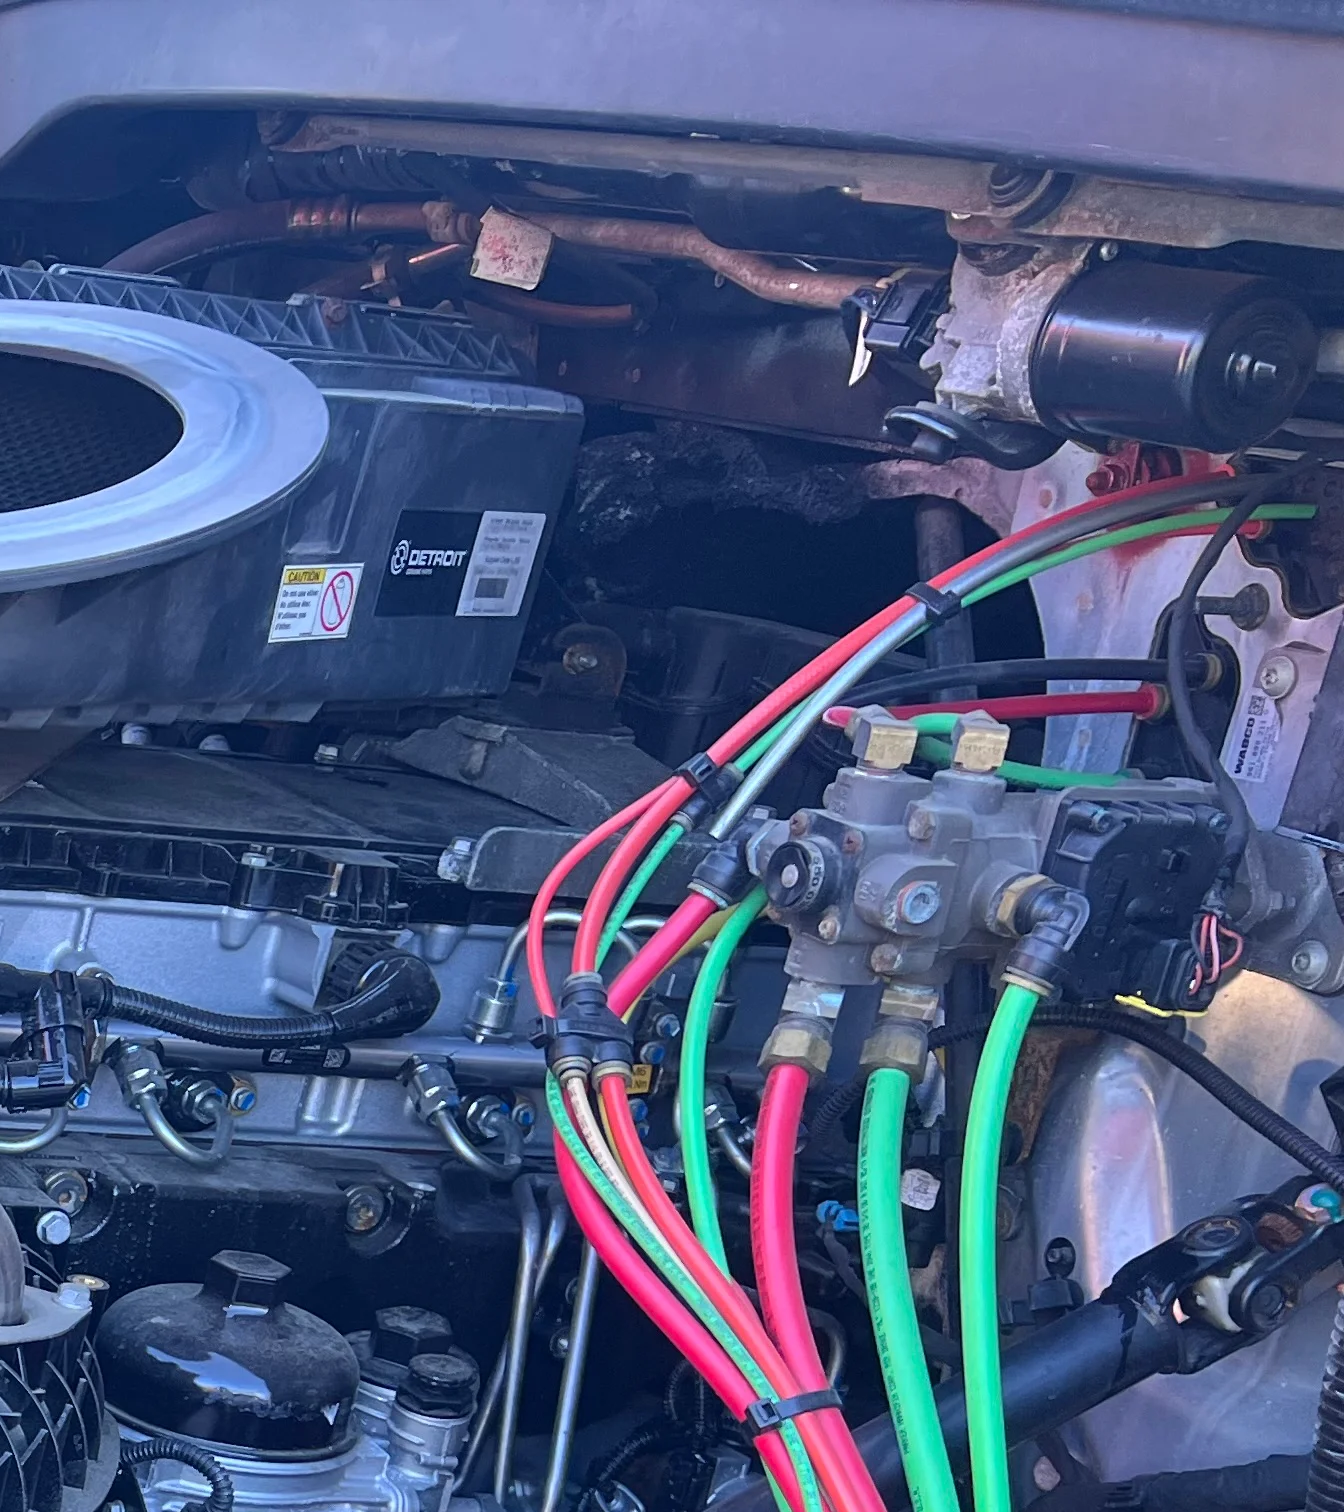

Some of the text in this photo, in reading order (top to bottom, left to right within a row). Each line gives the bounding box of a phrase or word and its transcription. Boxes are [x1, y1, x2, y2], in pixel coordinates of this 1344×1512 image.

[408, 550, 467, 567] DETROIT
[288, 571, 319, 582] CAUTION
[1234, 717, 1255, 774] WABCO
